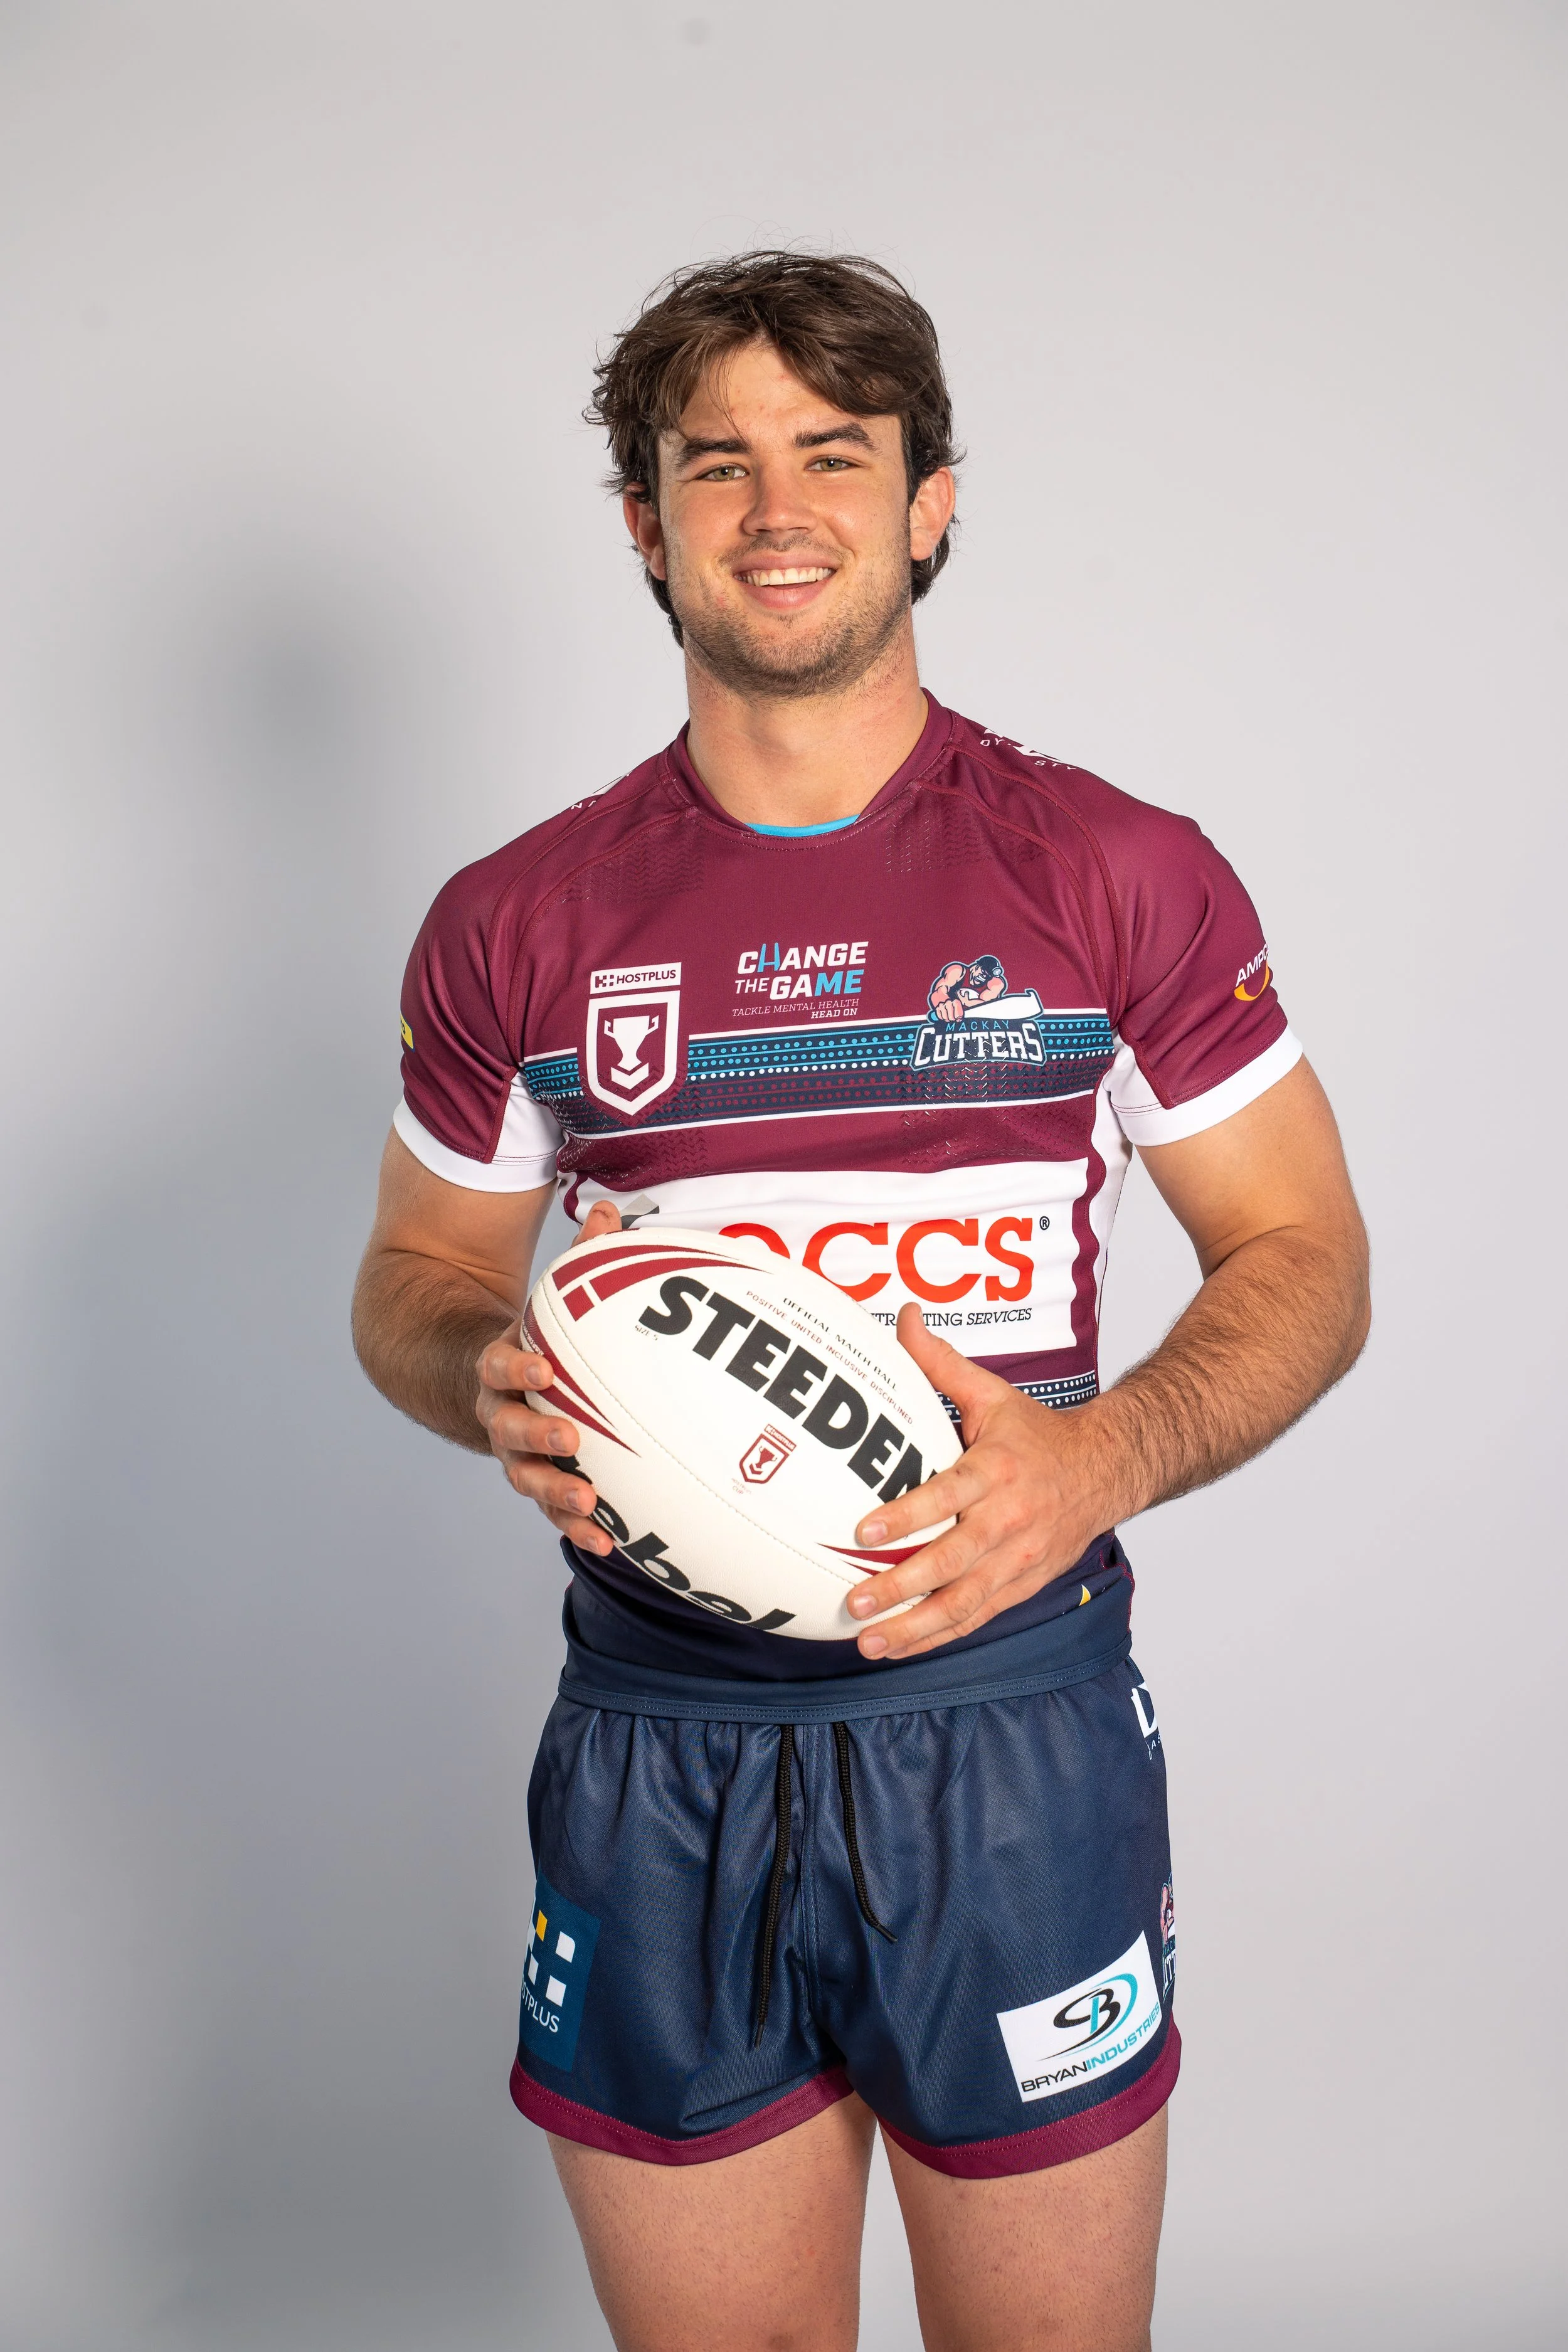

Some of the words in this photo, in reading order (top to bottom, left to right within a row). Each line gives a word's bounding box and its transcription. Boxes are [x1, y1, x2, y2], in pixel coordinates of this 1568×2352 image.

[738, 941, 869, 975] CHANGE
[616, 970, 676, 984] HOSTPLUS
[734, 977, 770, 994] THE
[770, 969, 864, 1000] GAME
[732, 1006, 771, 1017] TACKLE
[773, 1003, 815, 1014] MENTAL
[818, 999, 860, 1010] HEALTH
[810, 1009, 840, 1019] HEAD
[843, 1007, 858, 1017] ON
[945, 1020, 1009, 1032] MACKAY
[914, 1022, 1044, 1066] CUTTERS
[966, 1308, 1032, 1326] SERVICES
[783, 1297, 830, 1335] OFFICIAL
[835, 1334, 871, 1367] MATCH
[874, 1366, 897, 1392] BALL
